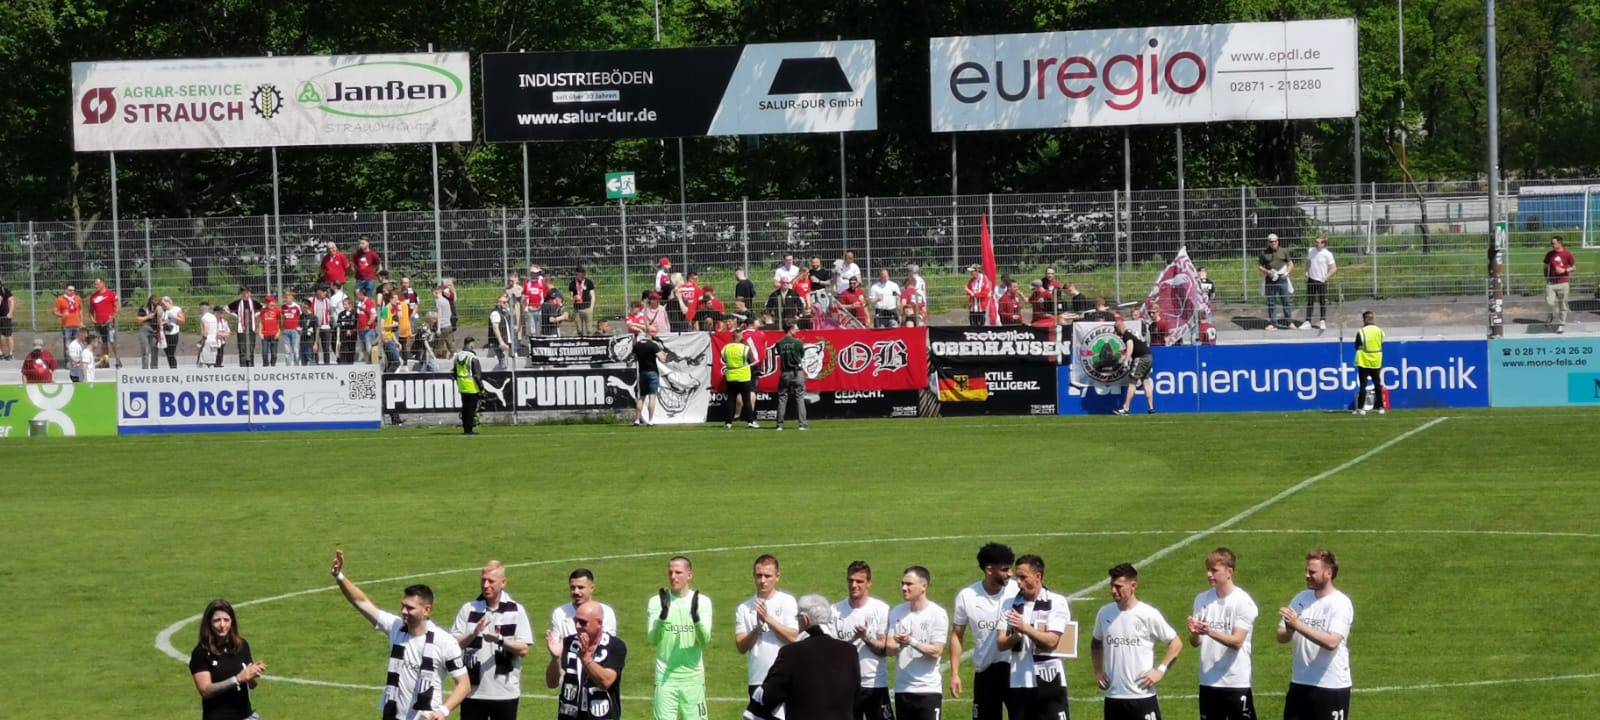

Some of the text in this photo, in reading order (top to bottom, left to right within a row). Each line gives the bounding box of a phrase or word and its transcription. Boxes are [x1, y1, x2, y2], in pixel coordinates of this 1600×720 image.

[1230, 48, 1321, 63] www.epdl.de
[518, 69, 653, 87] INDUSTRIEBÖDEN
[950, 38, 1207, 111] euregio
[123, 83, 242, 98] AGRAR-SERVICE
[326, 80, 447, 102] Janßen
[1230, 81, 1265, 92] 02871
[1277, 79, 1321, 91] 218280
[759, 98, 863, 110] SALUR-DUR GmbH
[123, 101, 244, 124] STRAUCH
[517, 108, 657, 125] www.salur-dur.de
[932, 341, 1071, 356] OBERHAUSEN
[1536, 347, 1546, 355] 71
[1502, 358, 1587, 367] www.mono-fels.de
[253, 372, 338, 381] DURCHSTARTEN.
[985, 372, 1013, 380] XTILE
[1136, 356, 1477, 400] anierungstchnik
[517, 376, 605, 406] PUMA
[986, 381, 1040, 390] ELLIGENZ.
[159, 389, 285, 417] BORGERS
[1240, 696, 1248, 711] 2
